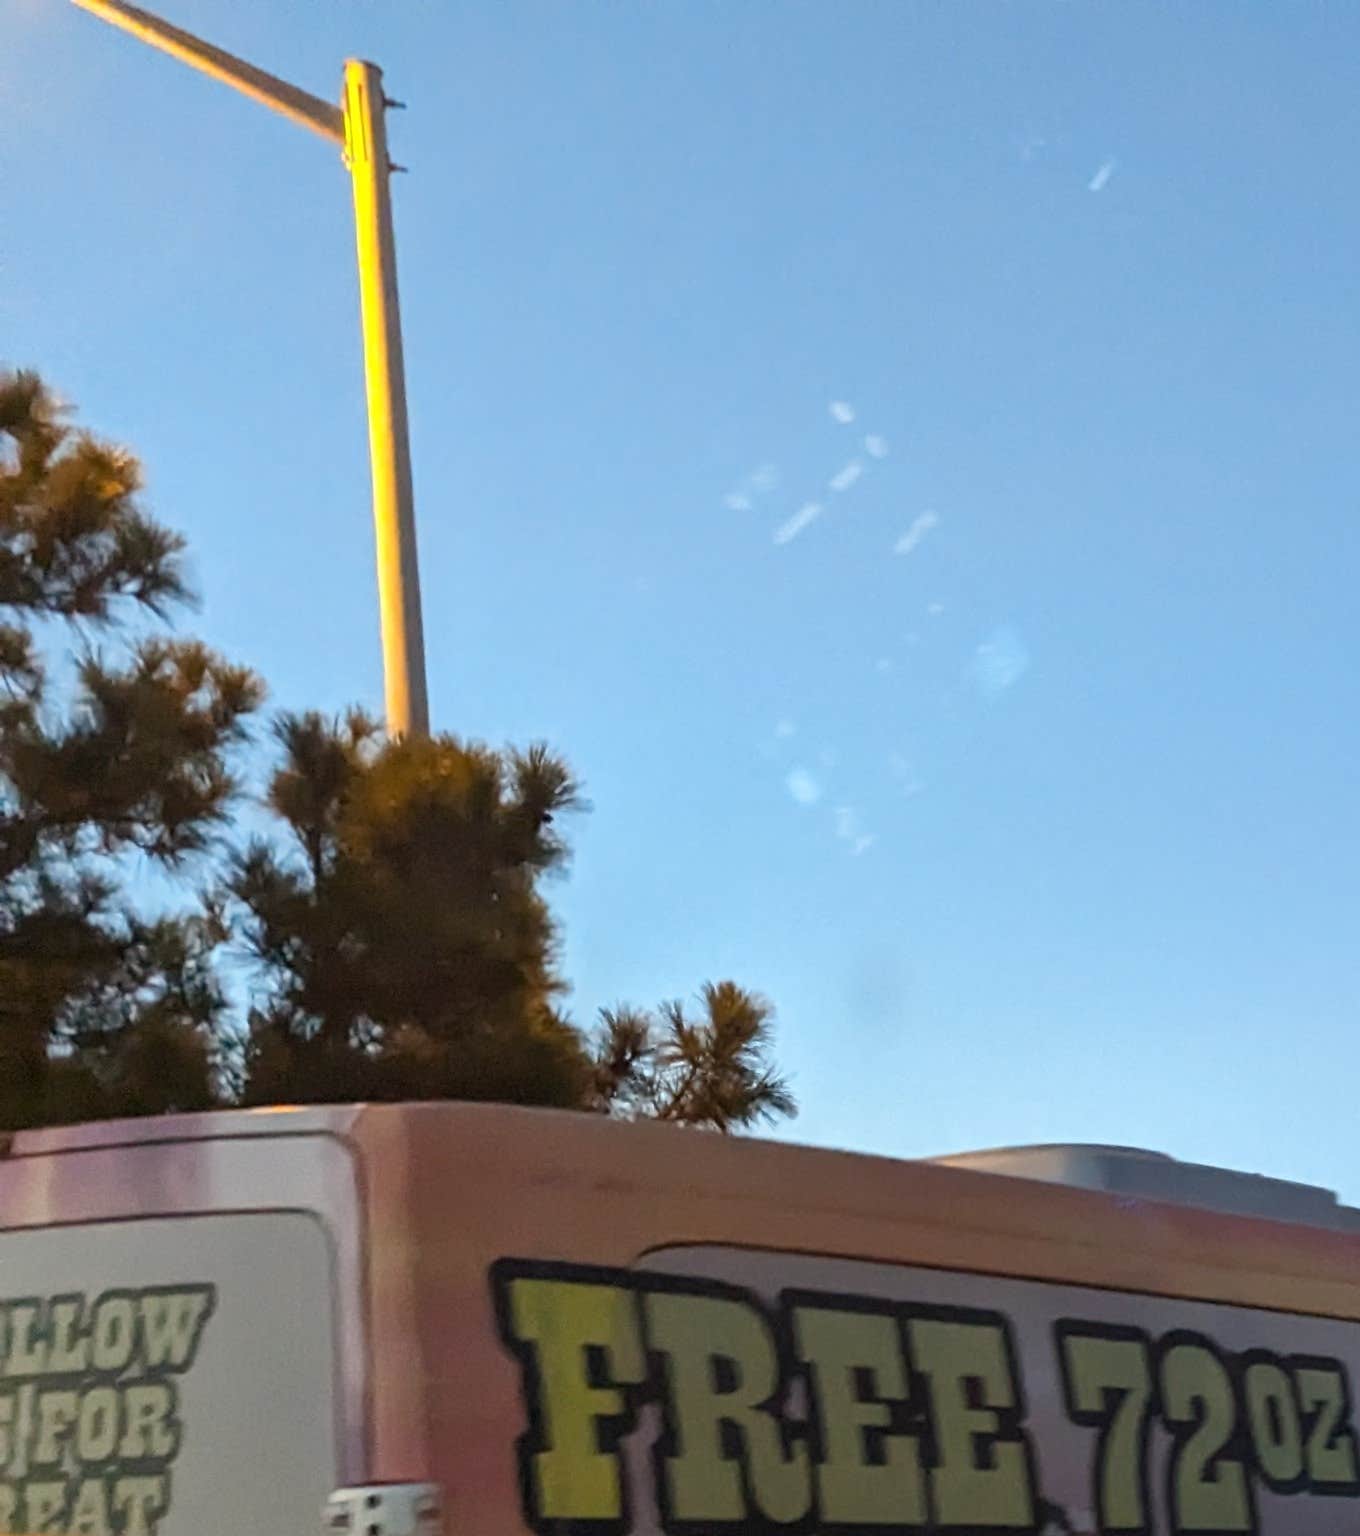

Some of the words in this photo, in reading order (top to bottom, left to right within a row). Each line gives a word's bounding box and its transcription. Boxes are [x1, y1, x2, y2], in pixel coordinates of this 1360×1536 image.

[0, 1285, 213, 1375] LLOW
[32, 1385, 179, 1463] FOR
[502, 1267, 1042, 1536] FREE
